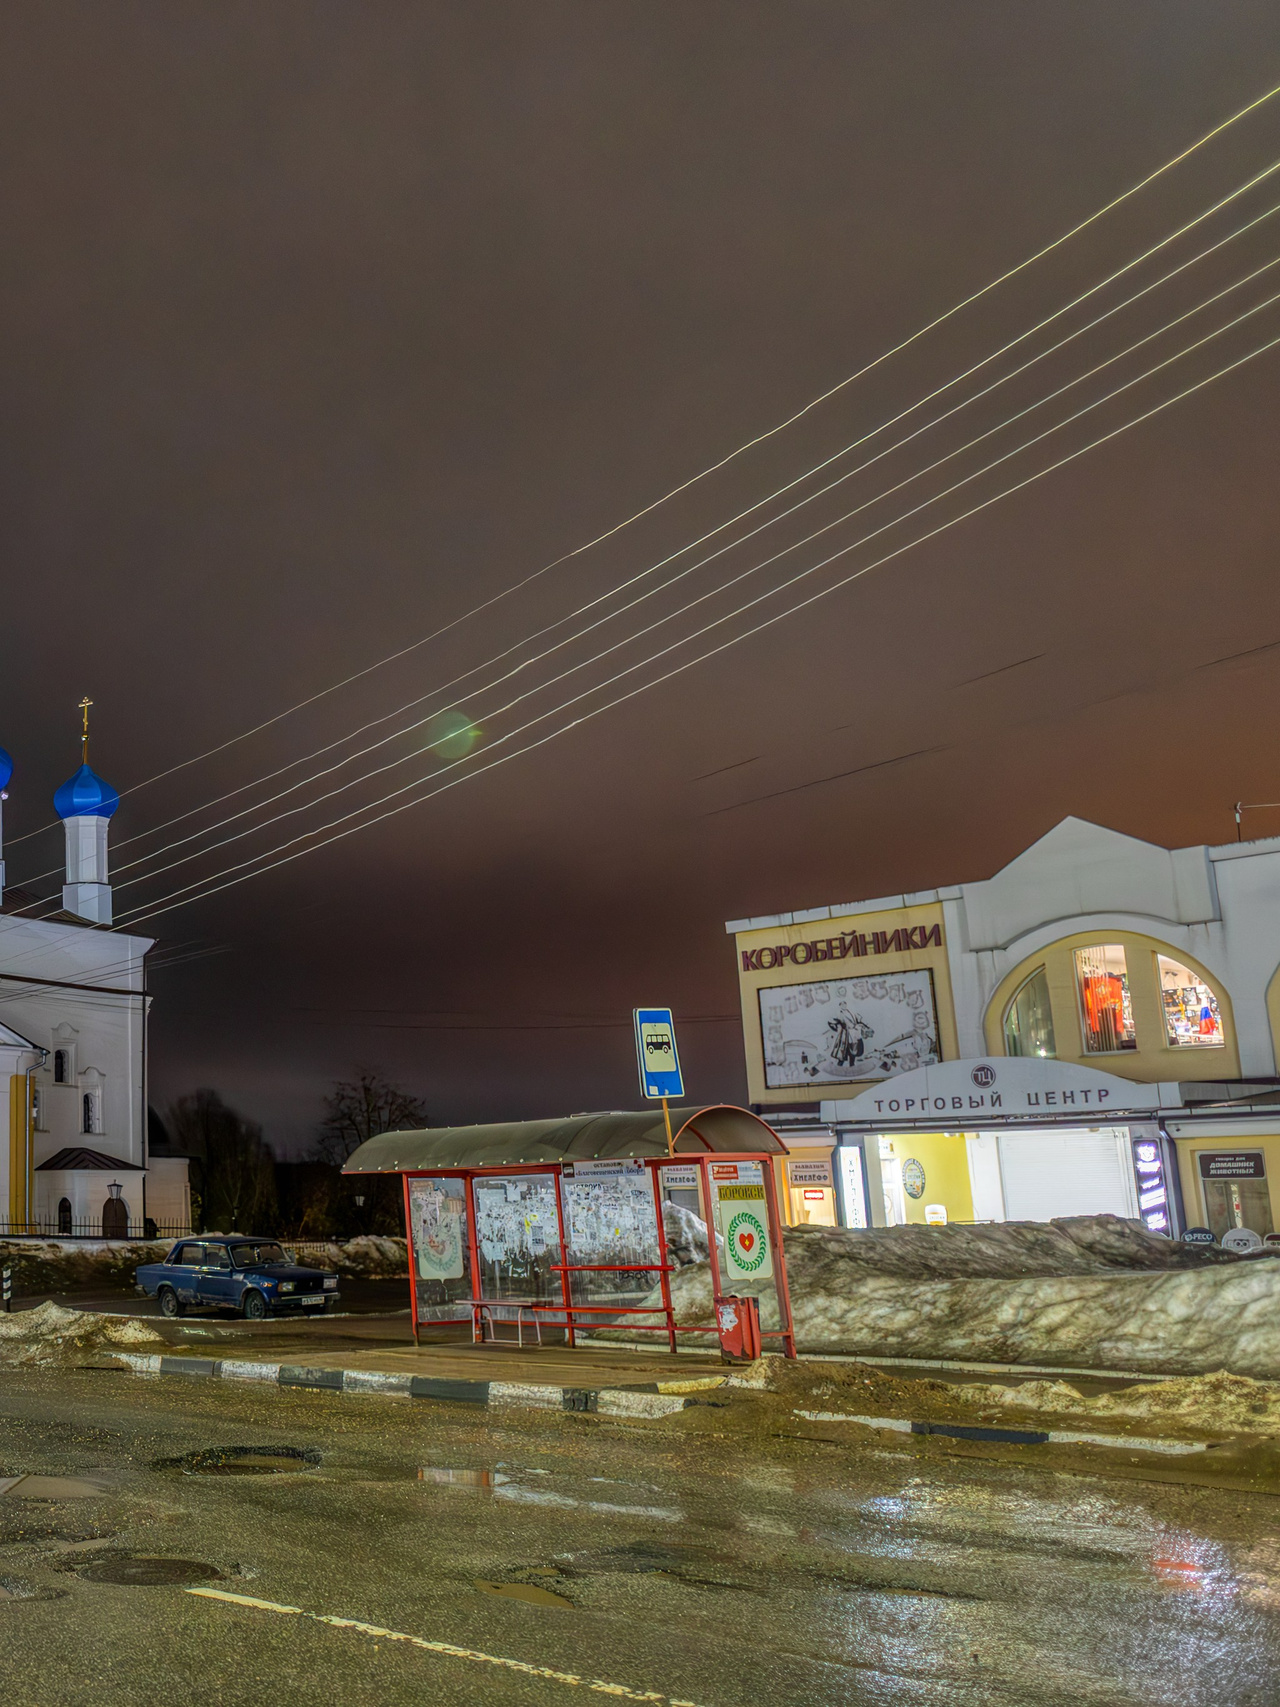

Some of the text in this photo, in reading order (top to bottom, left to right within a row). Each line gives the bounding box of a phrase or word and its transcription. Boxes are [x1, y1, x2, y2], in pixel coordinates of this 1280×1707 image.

[741, 923, 942, 971] КОРОБЕЙНИКИ
[874, 1089, 1110, 1113] ТОРГОВЫЙ ЦЕНТР
